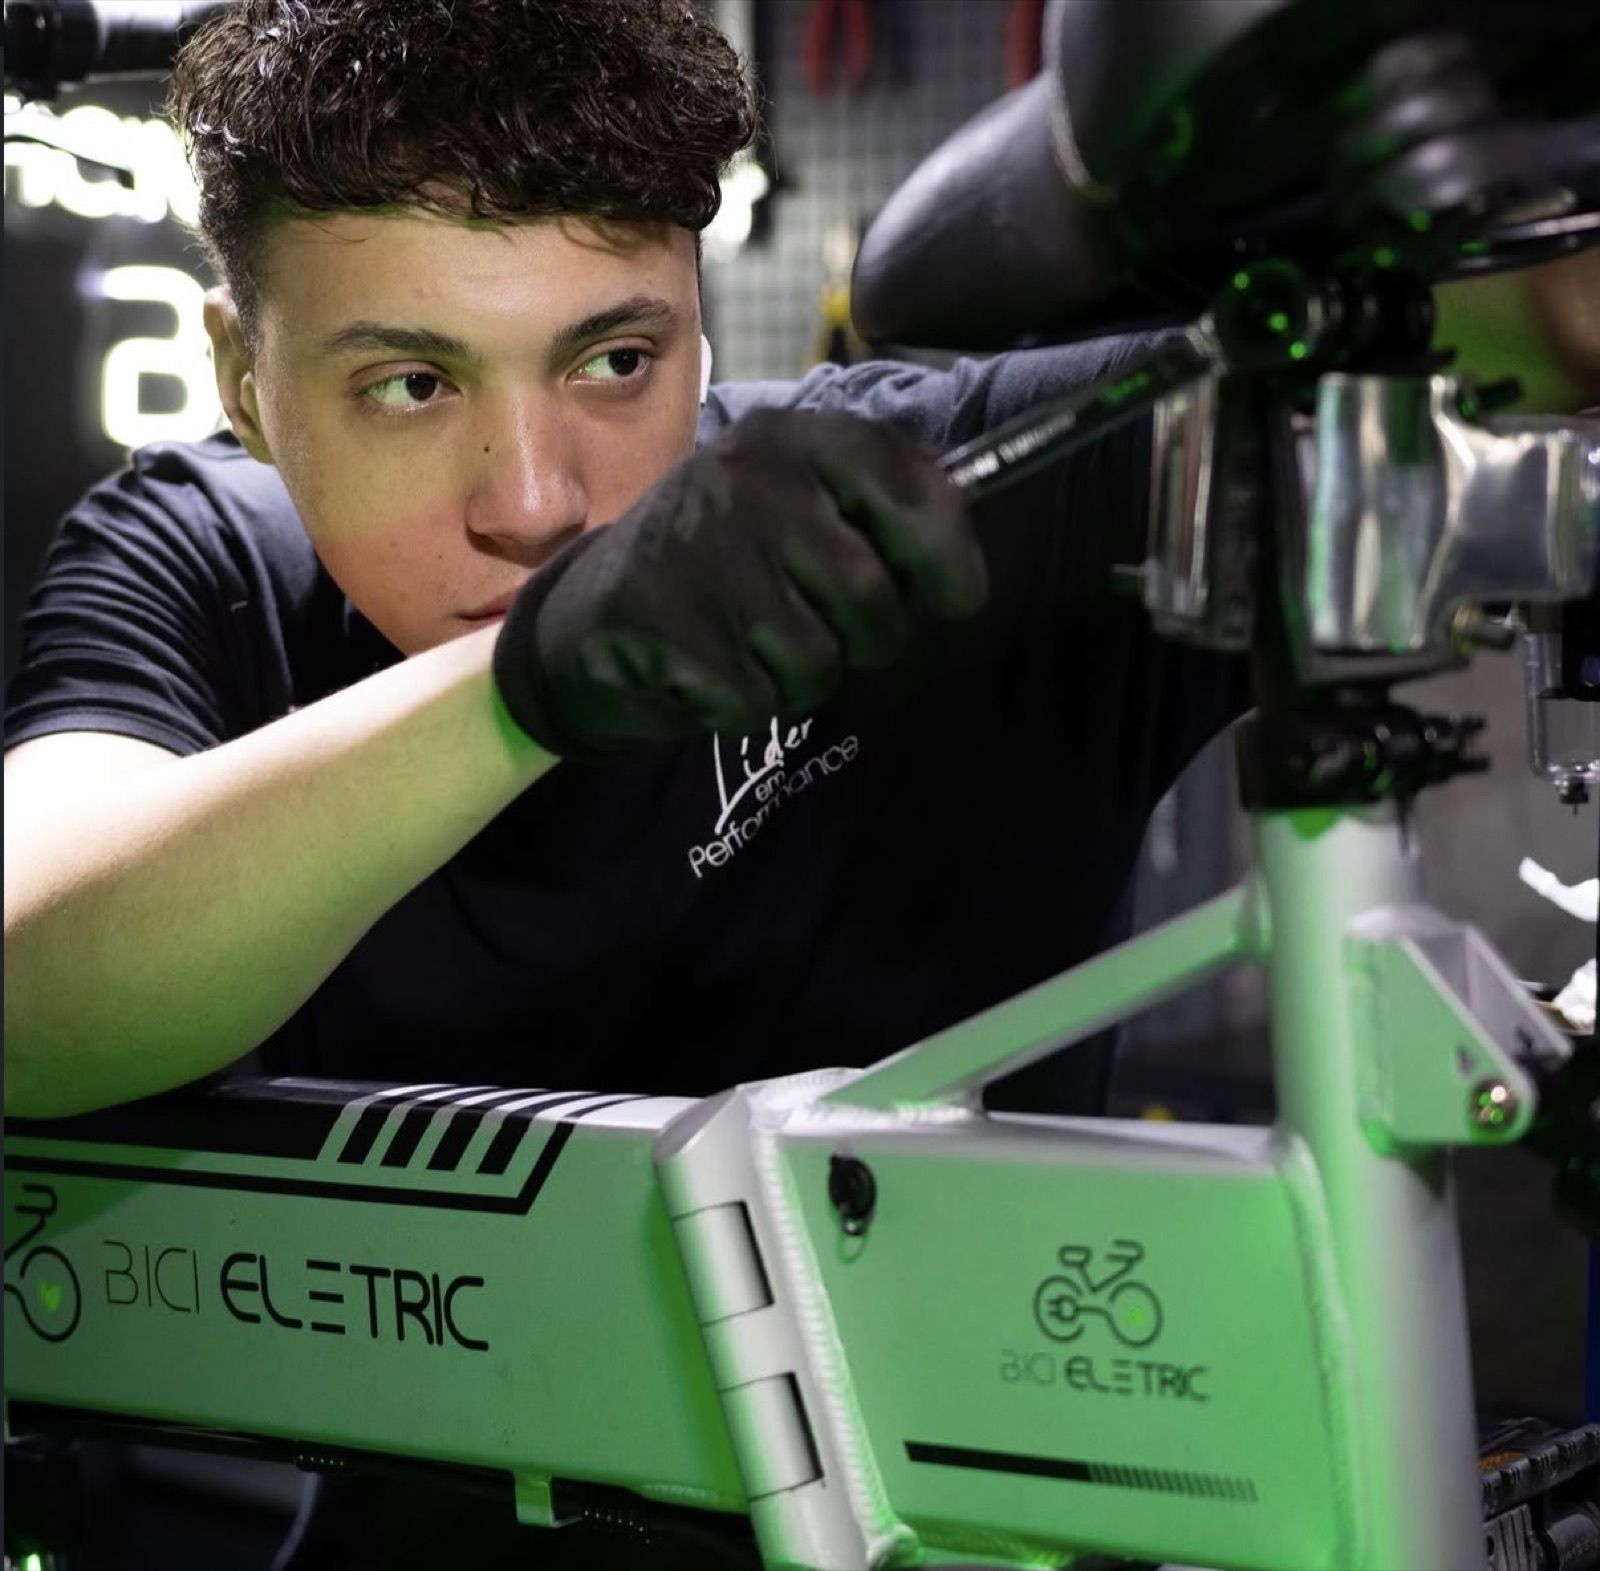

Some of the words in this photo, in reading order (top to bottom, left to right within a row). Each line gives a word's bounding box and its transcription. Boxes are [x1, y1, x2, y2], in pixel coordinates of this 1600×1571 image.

[688, 735, 859, 879] Performance
[754, 770, 786, 802] em
[103, 1241, 200, 1315] BICI
[220, 1252, 490, 1352] ELETRIC
[1065, 1355, 1210, 1403] ELETRIC
